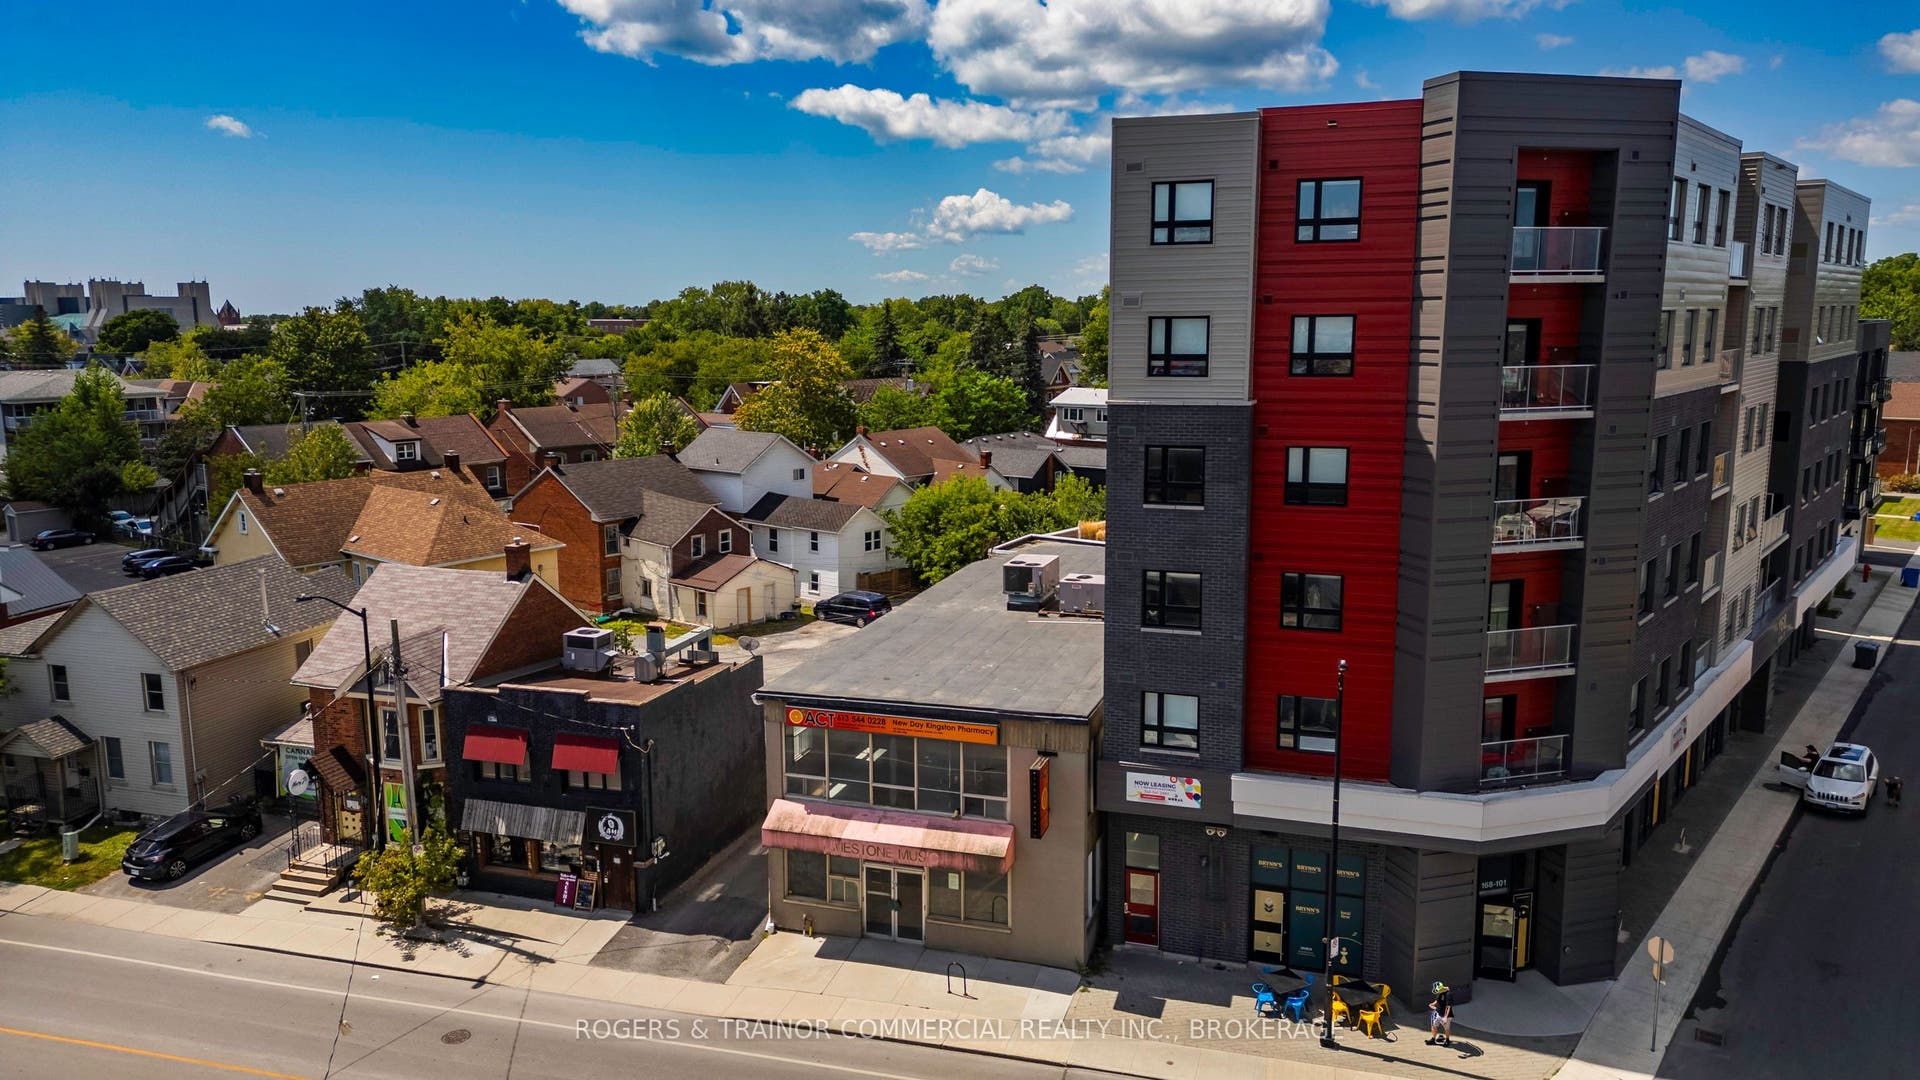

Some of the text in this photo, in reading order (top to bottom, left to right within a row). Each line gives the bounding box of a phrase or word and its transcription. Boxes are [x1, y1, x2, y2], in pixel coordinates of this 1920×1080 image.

[804, 711, 834, 728] ACT
[852, 715, 865, 723] 544
[867, 717, 886, 726] 0228
[893, 719, 908, 727] New
[910, 720, 924, 730] Day
[926, 722, 956, 732] Kingston
[958, 725, 994, 736] Pharmacy
